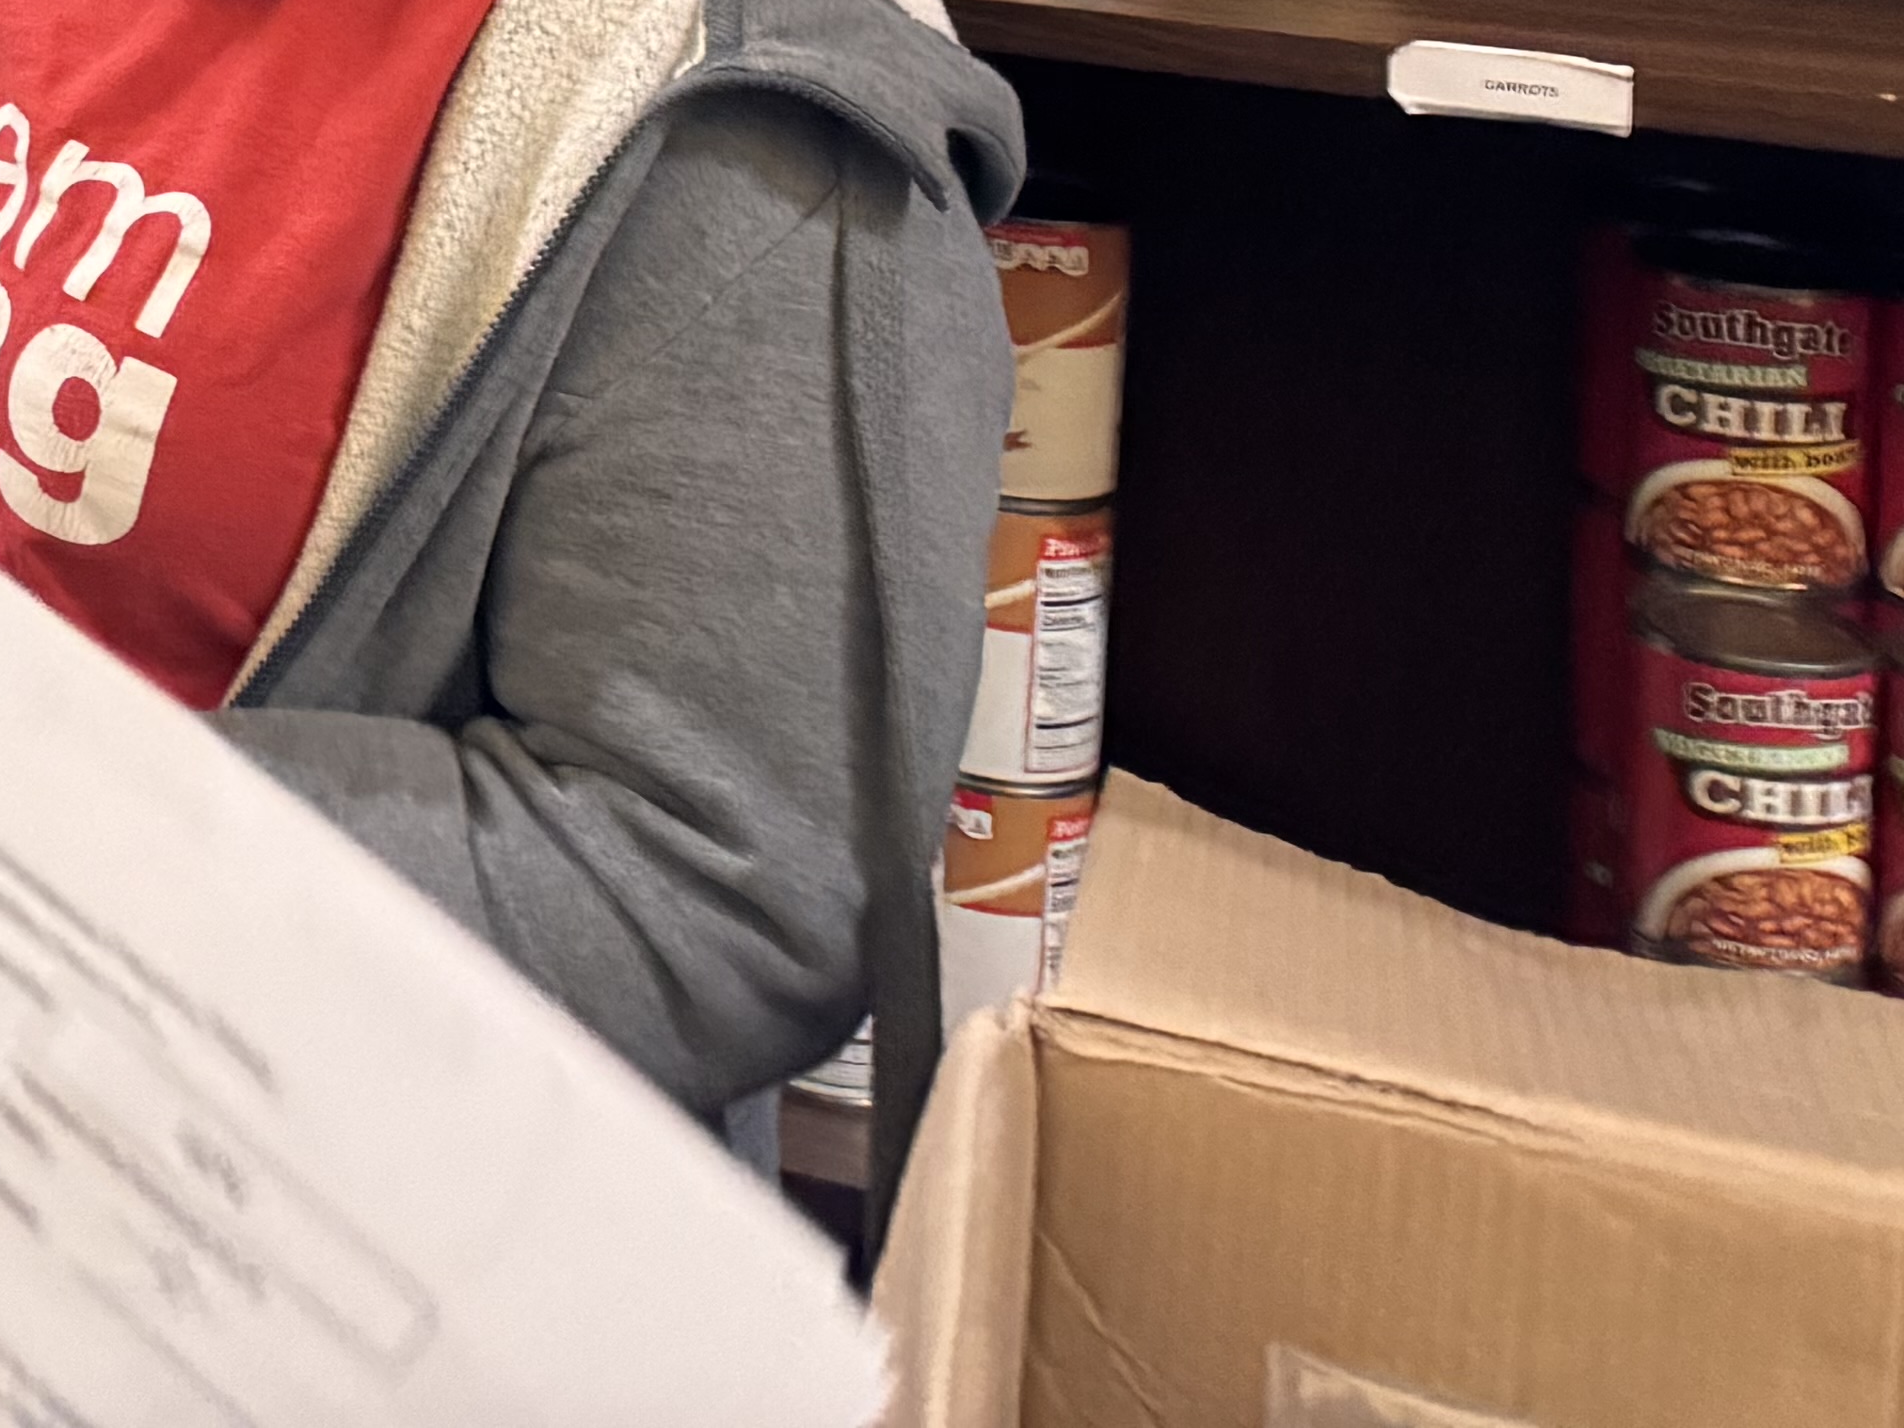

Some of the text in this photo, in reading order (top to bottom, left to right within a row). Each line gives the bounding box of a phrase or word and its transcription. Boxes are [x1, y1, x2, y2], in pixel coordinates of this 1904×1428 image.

[1485, 79, 1559, 97] CARROTS
[1654, 301, 1851, 360] Southgate
[1658, 384, 1846, 442] CHILI
[1692, 770, 1873, 824] CHIL
